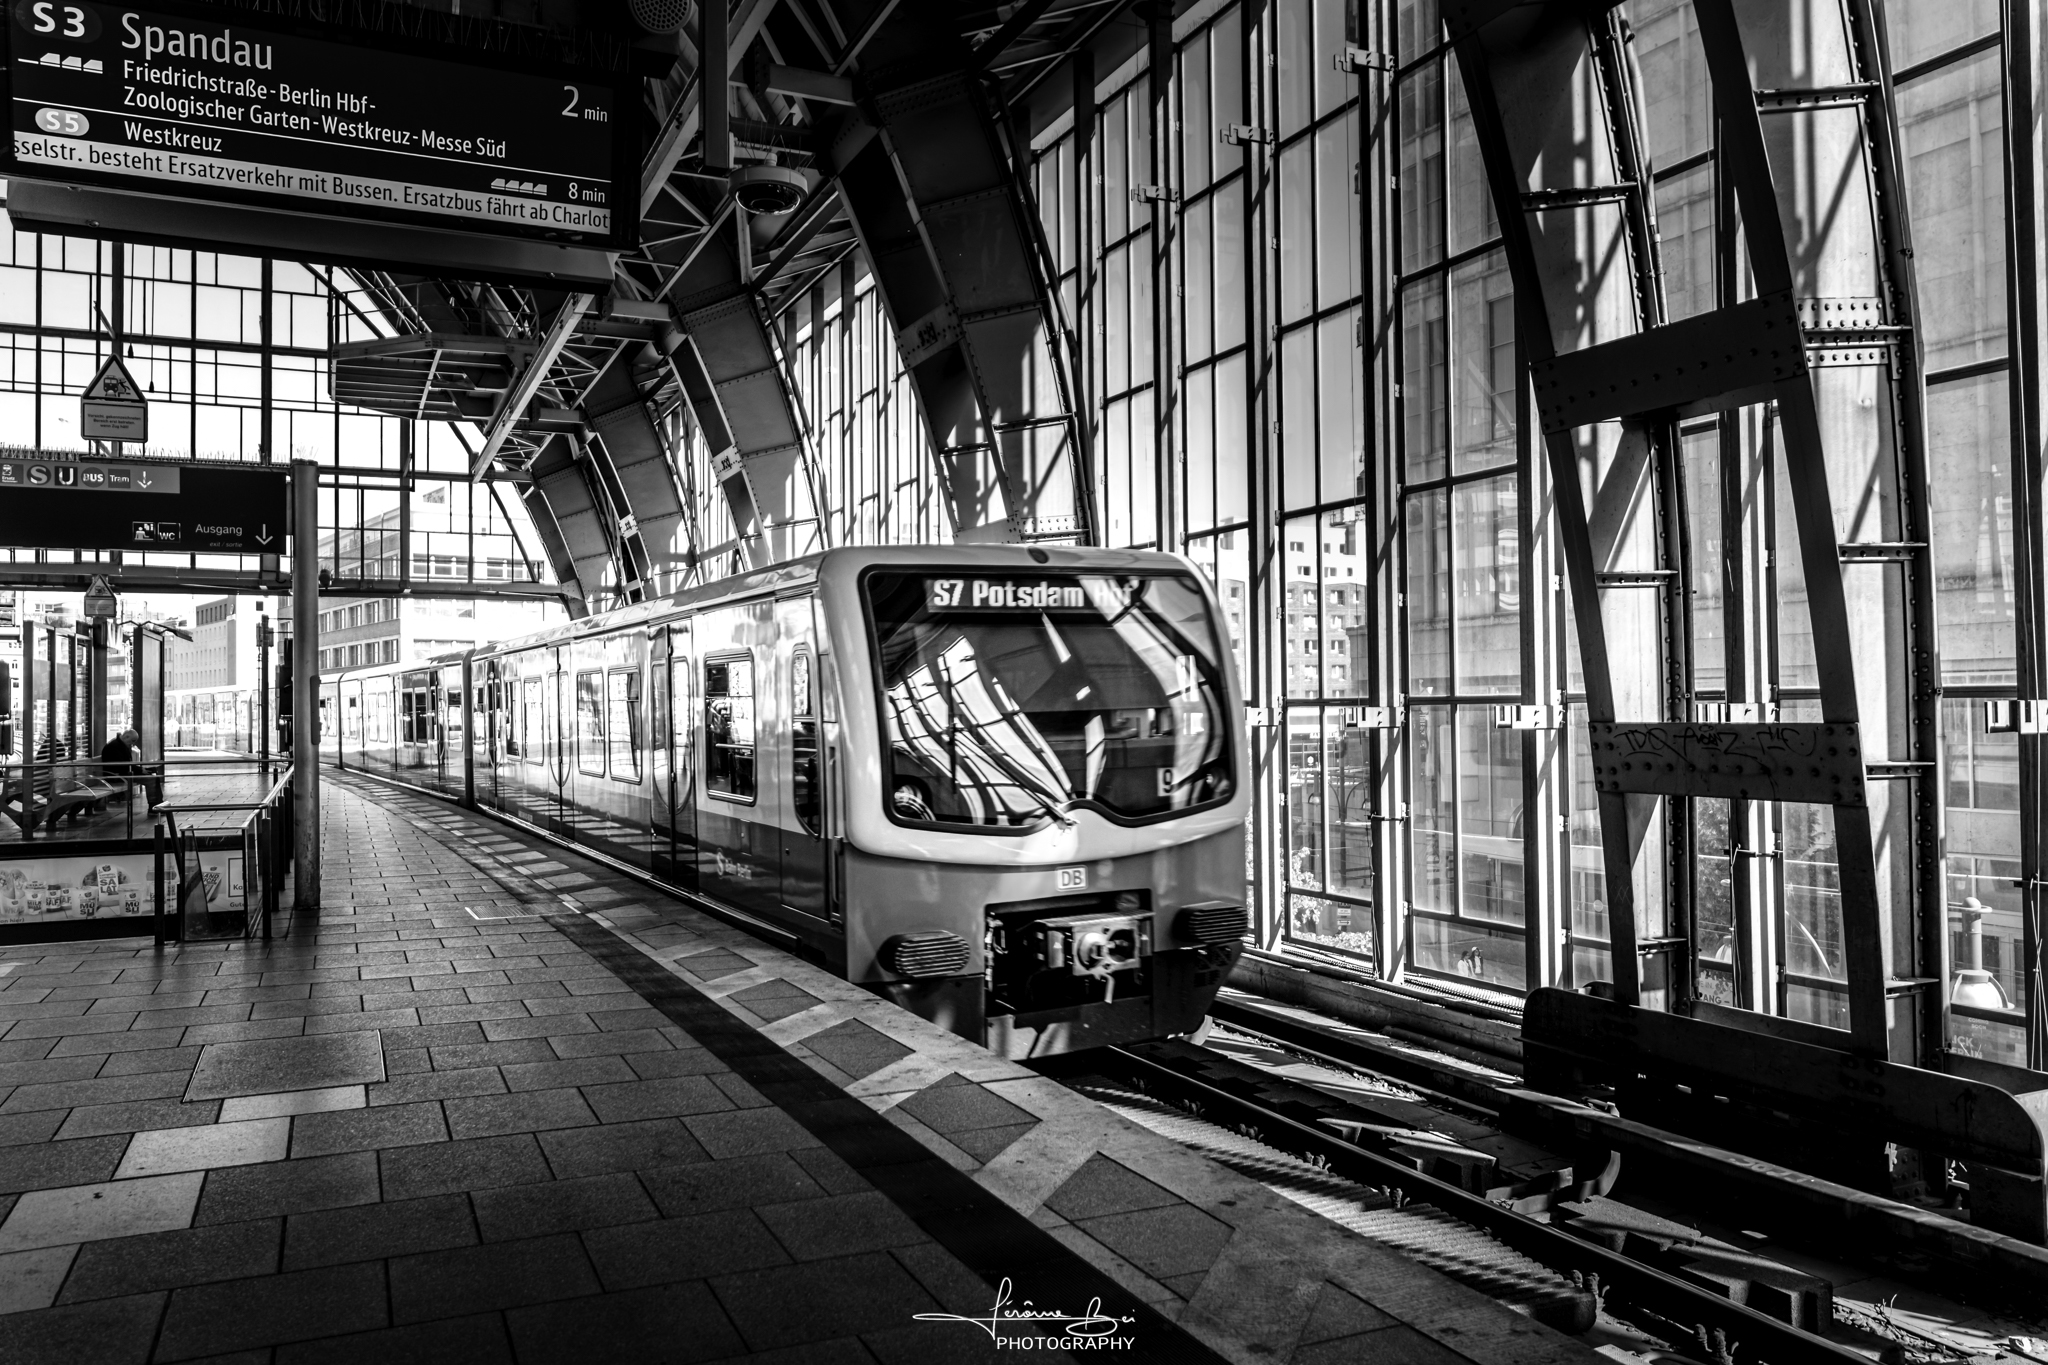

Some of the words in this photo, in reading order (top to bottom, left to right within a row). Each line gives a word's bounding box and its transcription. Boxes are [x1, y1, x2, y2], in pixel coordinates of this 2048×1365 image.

[121, 12, 272, 71] Spandau
[561, 85, 579, 118] 2
[584, 107, 608, 123] min
[123, 85, 245, 123] Zoologischer
[476, 138, 506, 159] Süd
[124, 121, 223, 153] Westkreuz
[89, 144, 163, 173] besteht
[168, 154, 294, 189] Ersatzverkehr
[299, 174, 328, 194] mit
[333, 176, 398, 203] Bussen.
[403, 185, 482, 213] Ersatzbus
[487, 196, 526, 219] fährt
[530, 204, 548, 221] ab
[568, 182, 579, 200] 8
[582, 187, 606, 204] min
[30, 465, 49, 485] S
[58, 467, 75, 485] U
[109, 474, 130, 483] Tram
[159, 532, 176, 541] WC
[195, 523, 243, 537] Ausgang
[933, 579, 965, 607] S7
[972, 579, 1085, 608] Potsdam
[1061, 869, 1083, 887] DB
